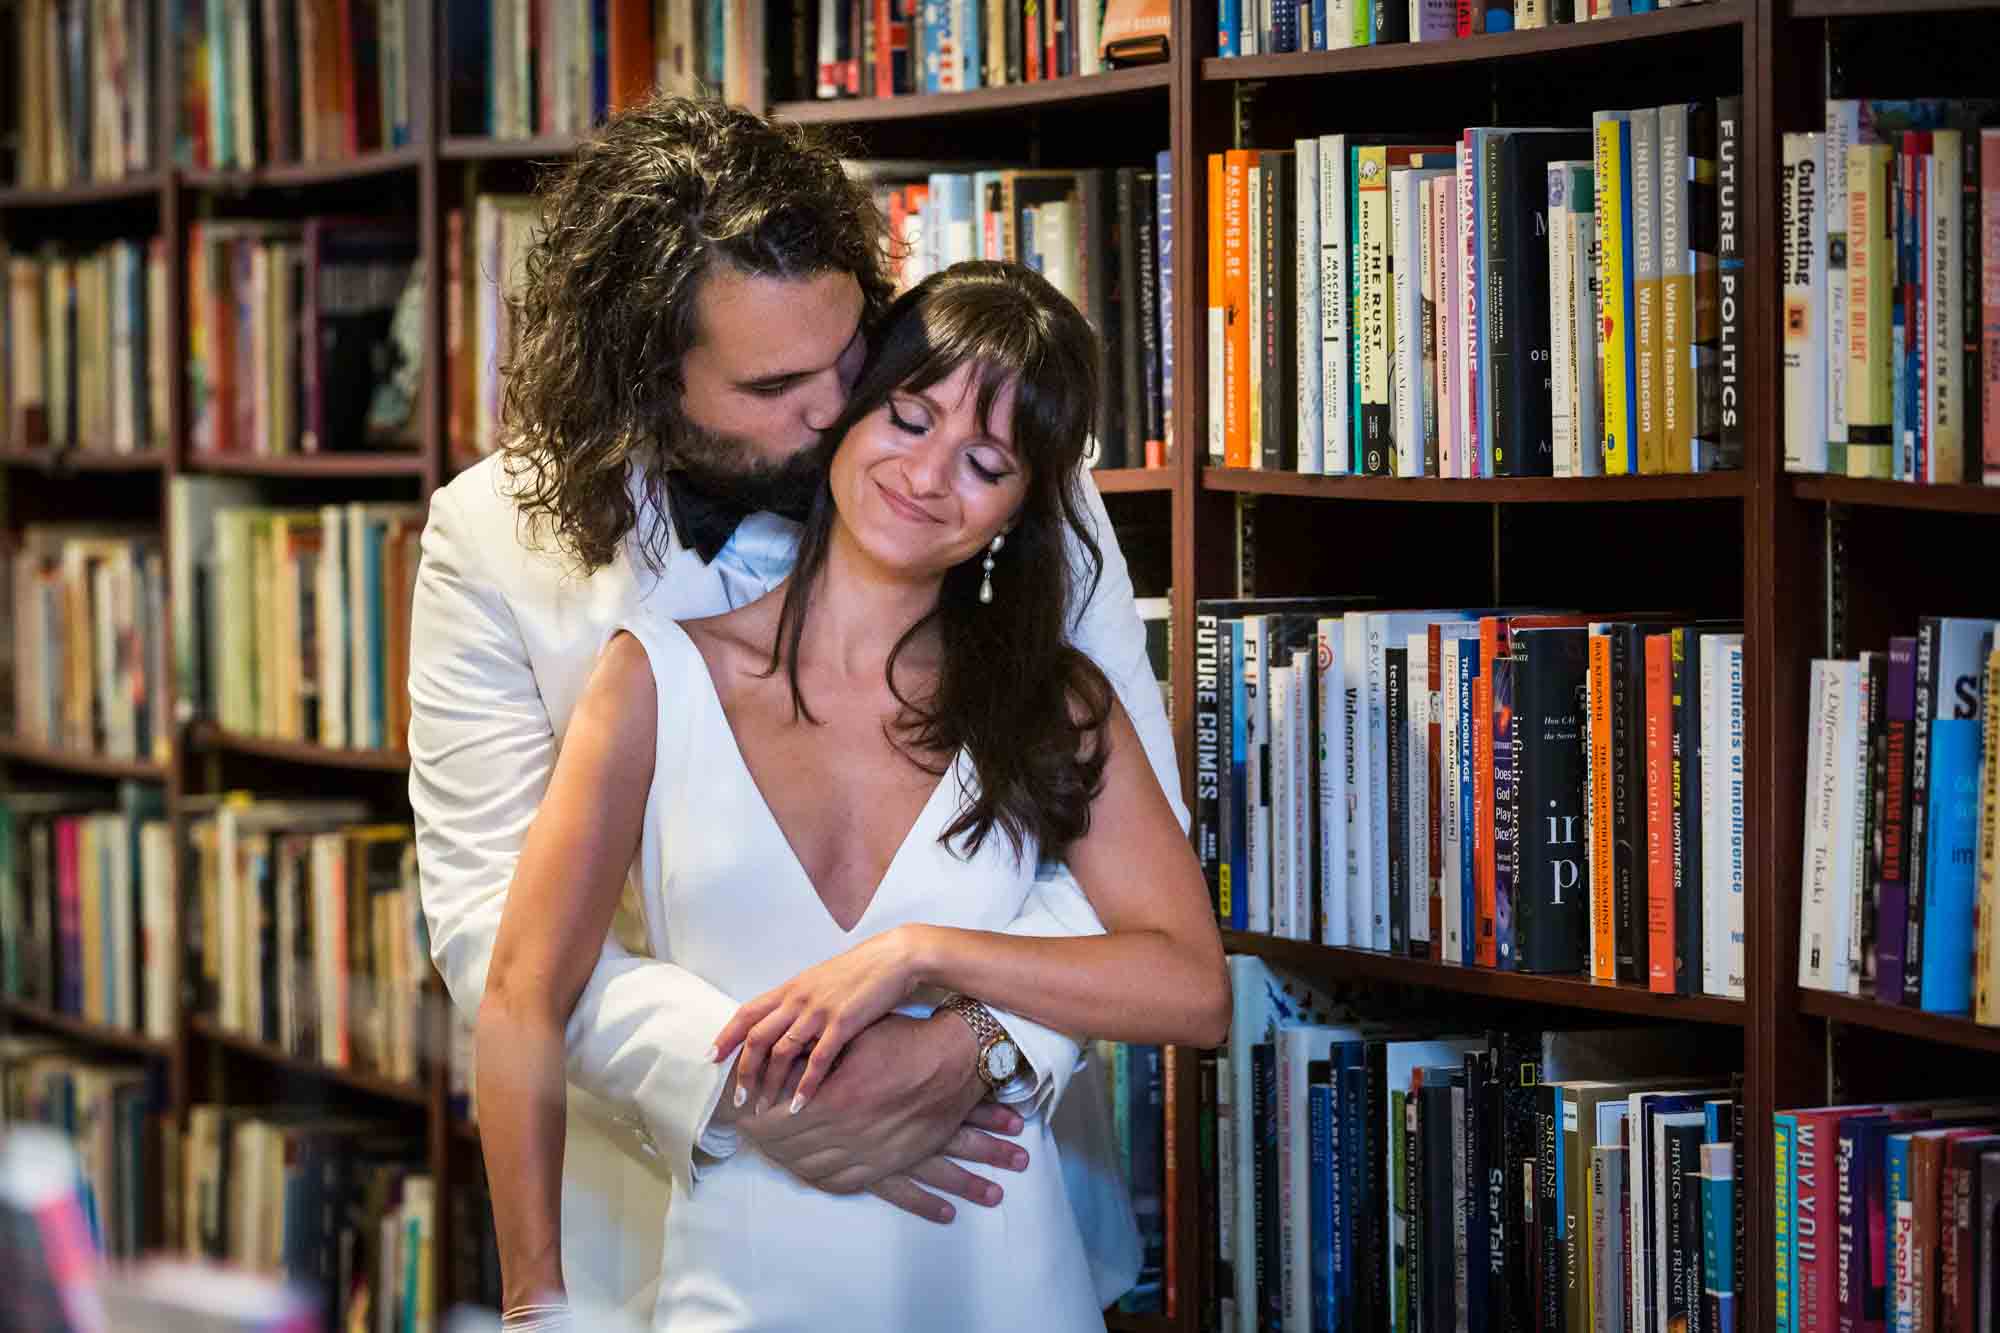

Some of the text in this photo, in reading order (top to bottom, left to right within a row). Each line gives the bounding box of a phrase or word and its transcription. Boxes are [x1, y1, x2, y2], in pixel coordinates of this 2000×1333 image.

[1438, 217, 1446, 254] Utopia
[1490, 143, 1499, 251] CHAOS MONKEYS
[1601, 136, 1611, 305] NEVER LOST AGAIN
[1637, 141, 1651, 272] INNOVATORS
[1664, 136, 1677, 269] INNOVATORS
[1784, 163, 1796, 285] Revolution
[1795, 159, 1815, 286] Cultivating
[1332, 260, 1340, 326] MACHINE
[1362, 200, 1371, 392] PROGRAMMING LANGUAGE
[1370, 241, 1382, 351] THE RUST
[1439, 256, 1446, 268] of
[1464, 150, 1478, 371] HUMAN MACHINE
[1720, 119, 1737, 428] FUTURE POLITICS
[1937, 246, 1947, 351] PROPERTY
[1640, 287, 1652, 432] Walter Isaacson
[1665, 283, 1677, 429] Walter Isaacson
[1937, 357, 1947, 377] IN
[1937, 386, 1948, 426] MAN
[1197, 615, 1218, 800] FUTURE CRIMES
[1245, 639, 1257, 698] FLIP
[1919, 625, 1931, 683] THE
[1344, 687, 1358, 785] Videocracy
[1389, 664, 1400, 812] technoromanticism
[1461, 657, 1471, 784] THE NEW MOBILE AGE
[1494, 767, 1512, 781] Does
[1615, 631, 1625, 825] THE SPACE BARONS
[1731, 650, 1744, 893] Architects of Intelligence
[1821, 671, 1841, 829] A Different Mirror
[1914, 687, 1929, 789] STAKES
[1448, 730, 1456, 837] BRAINCHILDREN
[1494, 826, 1513, 841] Dice?
[1495, 807, 1512, 823] Play
[1496, 786, 1511, 801] God
[1511, 716, 1524, 884] infinite powers
[1649, 716, 1659, 865] THE YOUTH PILL
[1672, 733, 1682, 888] THE MEDEA HYPOTHESIS
[1984, 804, 1995, 860] NATION
[1813, 848, 1827, 904] Takaki
[1466, 1106, 1475, 1128] The
[1546, 1114, 1555, 1199] ORIGINS
[1797, 1123, 1816, 1188] WHY
[1488, 1167, 1505, 1274] StarTalk
[1594, 1157, 1604, 1196] Gould
[1671, 1138, 1683, 1305] PHYSICS ON THE FRINGE
[1797, 1196, 1817, 1261] YOU
[1836, 1136, 1854, 1304] Fault Lines
[1567, 1215, 1577, 1289] DARWIN
[1893, 1217, 1913, 1303] People
